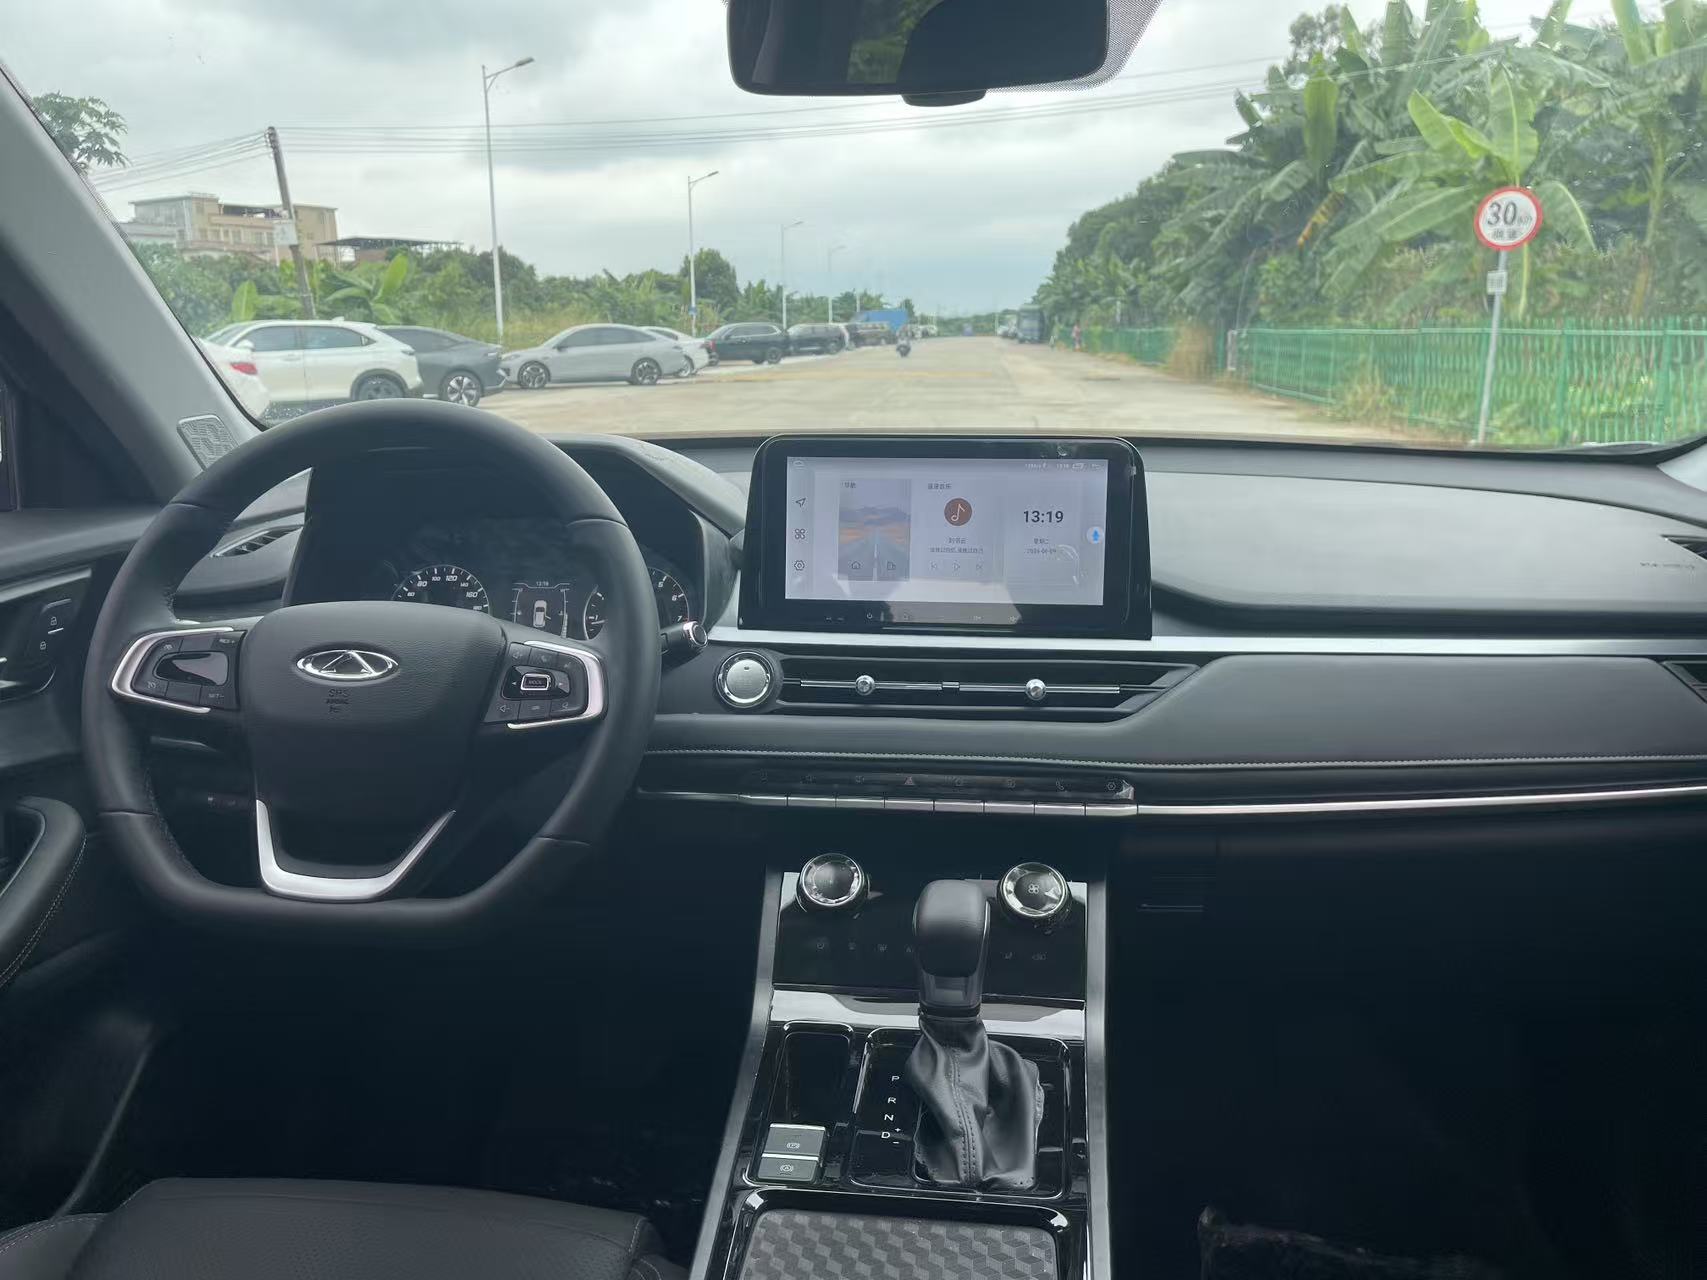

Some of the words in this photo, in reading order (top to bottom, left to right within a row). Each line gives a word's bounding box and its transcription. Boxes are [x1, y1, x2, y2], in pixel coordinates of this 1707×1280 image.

[1487, 201, 1517, 225] 30
[1024, 510, 1064, 523] 13:19
[887, 1096, 897, 1104] R
[884, 1113, 894, 1121] N
[881, 1131, 891, 1139] D
